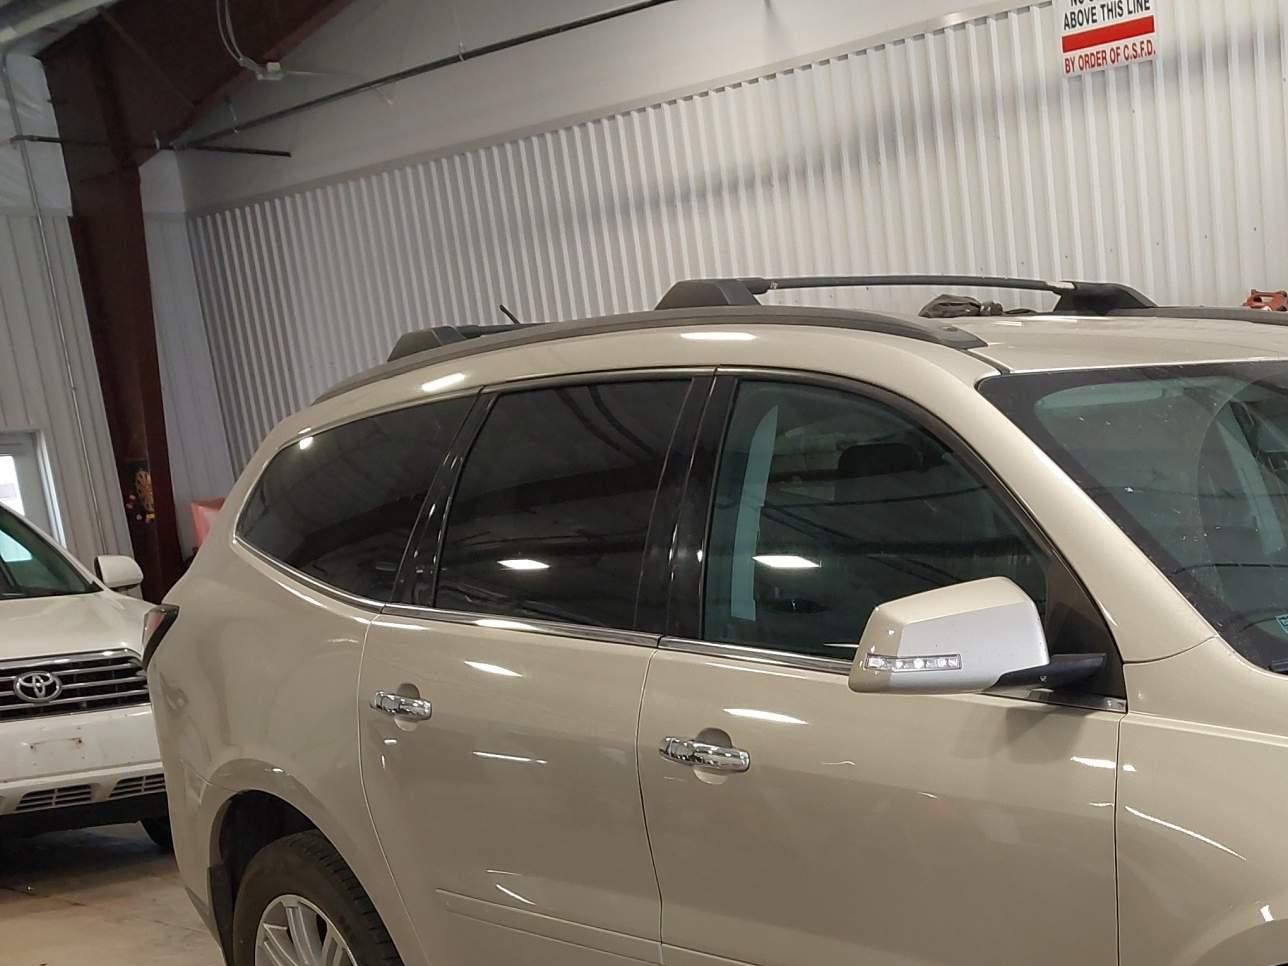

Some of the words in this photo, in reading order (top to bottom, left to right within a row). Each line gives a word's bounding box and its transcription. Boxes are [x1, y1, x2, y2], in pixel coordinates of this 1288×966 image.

[1064, 6, 1098, 30] ABOVE
[1100, 0, 1124, 21] THIS
[1127, 0, 1150, 15] LINE
[1064, 56, 1076, 73] BY
[1078, 50, 1107, 71] ORDER
[1109, 46, 1121, 64] OF
